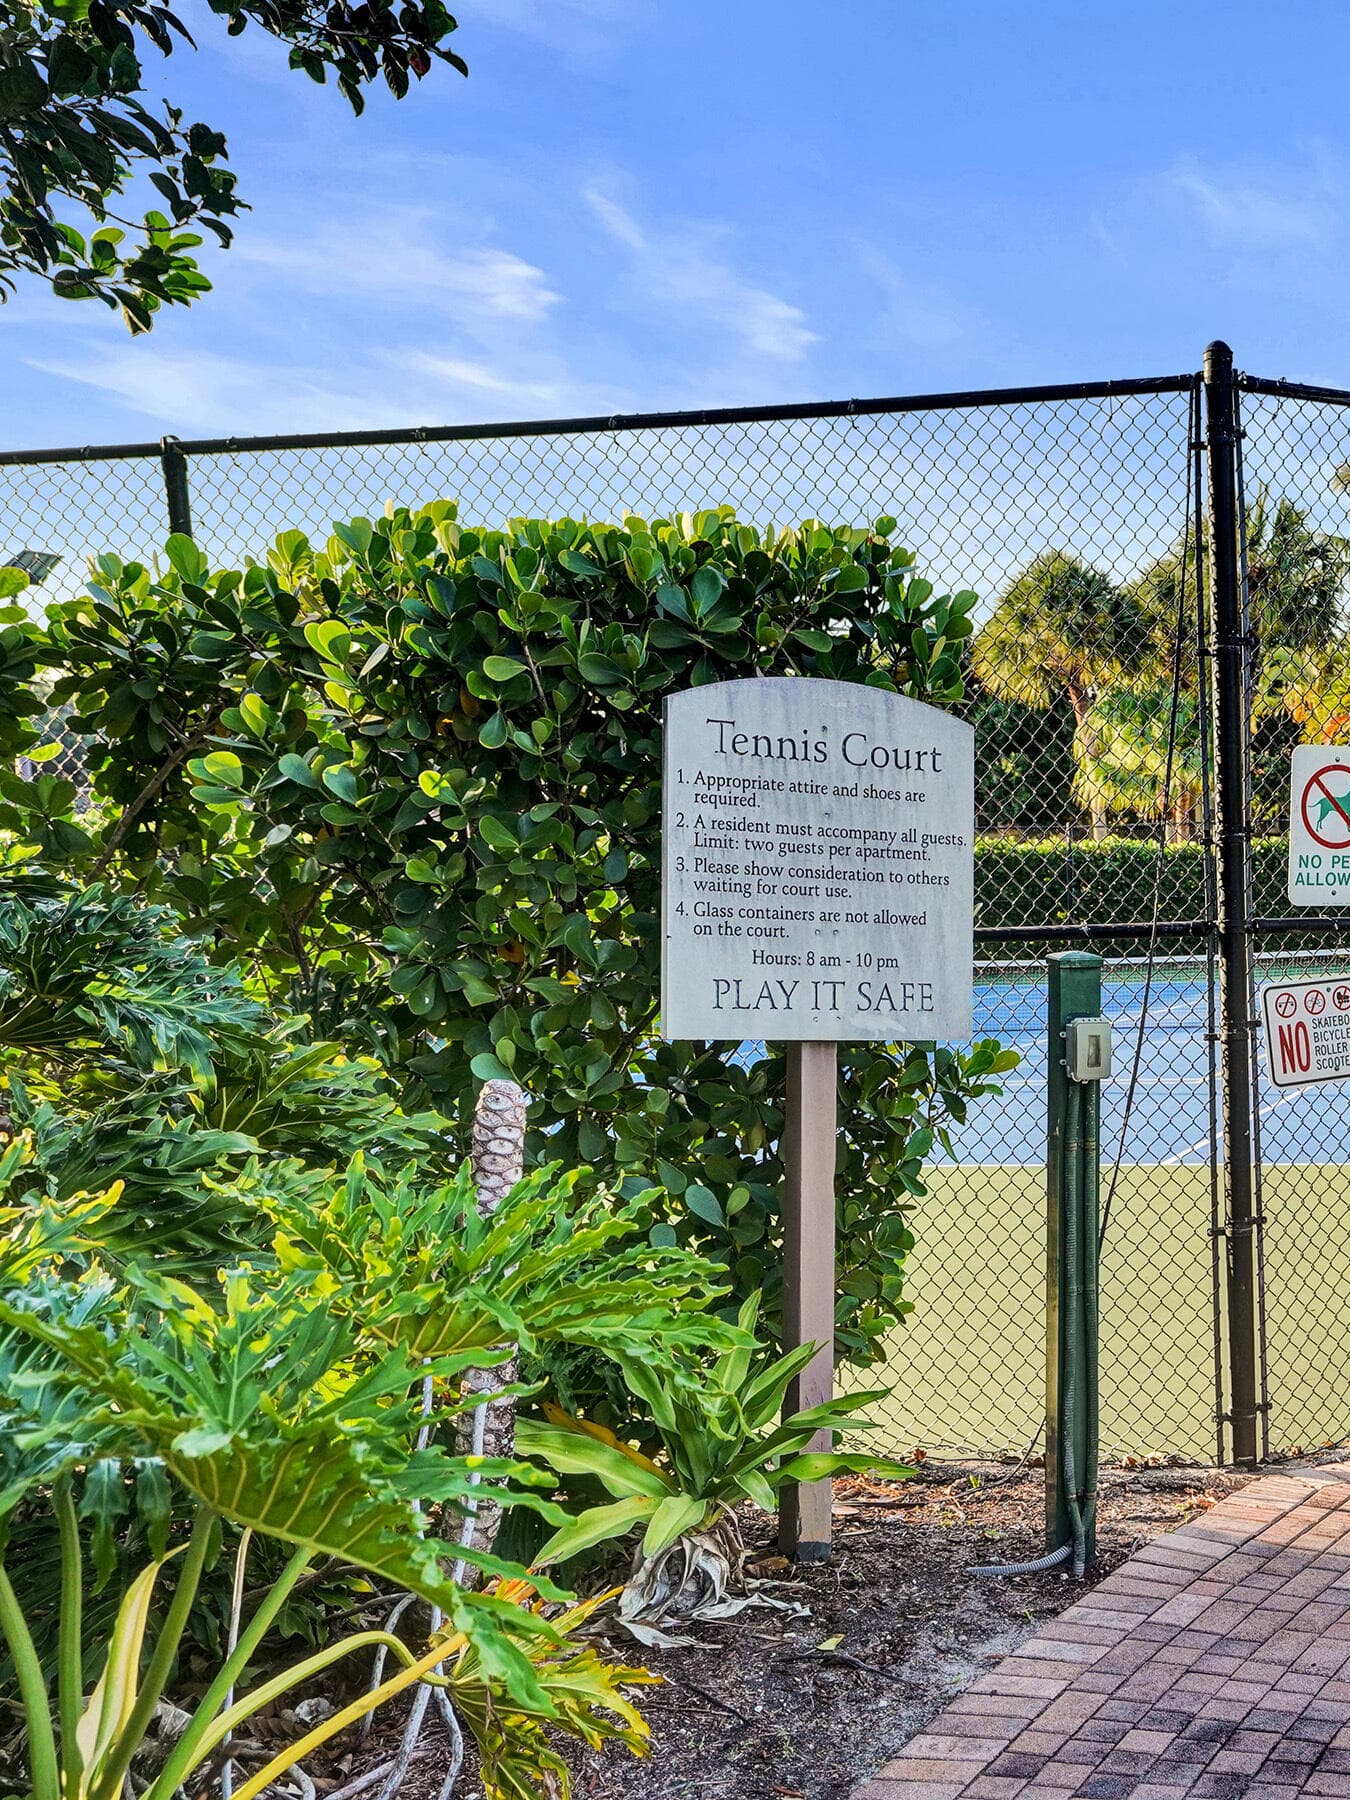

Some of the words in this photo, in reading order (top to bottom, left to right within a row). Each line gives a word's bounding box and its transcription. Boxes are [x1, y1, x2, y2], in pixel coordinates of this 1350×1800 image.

[706, 718, 828, 763] Tennis
[841, 733, 942, 773] Court
[677, 769, 689, 785] 1.
[694, 770, 785, 793] Appropriate
[789, 781, 828, 795] attire
[832, 783, 858, 798] and
[863, 784, 900, 801] shoes
[905, 791, 925, 803] are
[694, 791, 760, 809] required.
[676, 813, 689, 828] 2.
[694, 815, 705, 829] A
[711, 818, 770, 834] resident
[776, 823, 812, 836] must
[817, 827, 897, 845] accompany
[901, 828, 917, 843] all
[921, 833, 967, 848] guests.
[694, 833, 739, 850] Limit:
[745, 838, 774, 851] two
[779, 842, 824, 857] guests
[829, 845, 851, 861] per
[856, 846, 931, 860] apartment.
[676, 857, 689, 872] 3.
[694, 858, 739, 874] Please
[744, 863, 784, 878] show
[788, 866, 884, 883] consideration
[889, 872, 903, 884] to
[907, 873, 950, 886] others
[1299, 854, 1322, 868] NO
[694, 879, 752, 897] waiting
[757, 880, 777, 895] for
[782, 884, 820, 897] court
[825, 888, 852, 899] use.
[676, 902, 689, 916] 4.
[694, 902, 734, 918] Glass
[738, 907, 815, 921] containers
[819, 911, 840, 922] are
[845, 912, 869, 924] not
[873, 911, 926, 925] allowed
[694, 925, 712, 935] on
[718, 921, 742, 936] the
[746, 925, 789, 938] court.
[752, 950, 801, 966] Hours:
[807, 952, 815, 966] 8
[820, 956, 841, 967] am
[856, 953, 872, 967] 10
[877, 957, 899, 972] pm
[712, 979, 800, 1010] PLAY
[811, 981, 845, 1011] IT
[857, 982, 934, 1012] SAFE
[1278, 1021, 1311, 1073] NO
[1315, 1042, 1348, 1056] ROLLER
